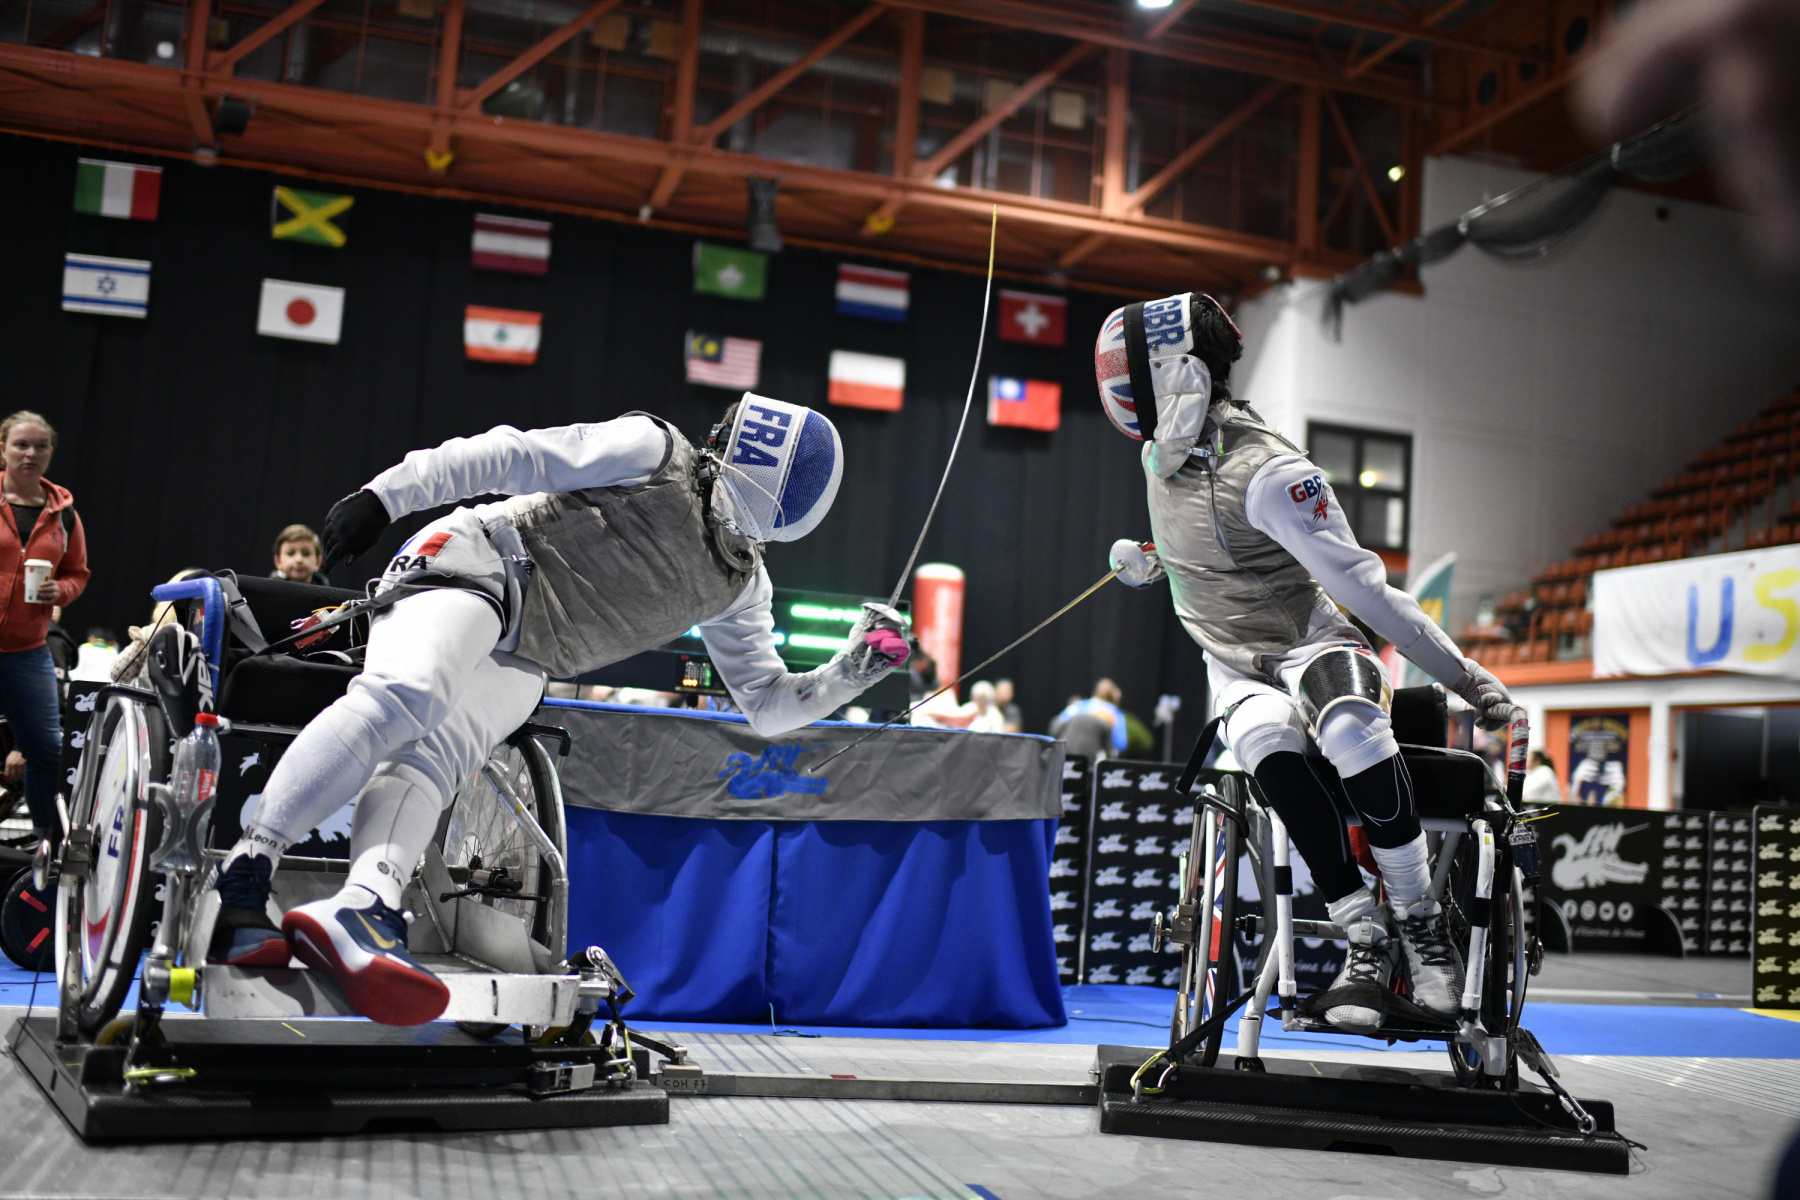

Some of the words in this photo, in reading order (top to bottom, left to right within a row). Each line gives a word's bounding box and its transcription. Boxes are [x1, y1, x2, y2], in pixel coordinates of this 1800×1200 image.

[1143, 299, 1185, 350] GBR
[732, 404, 793, 467] FRA
[248, 828, 278, 849] Leon
[693, 1079, 707, 1089] 77
